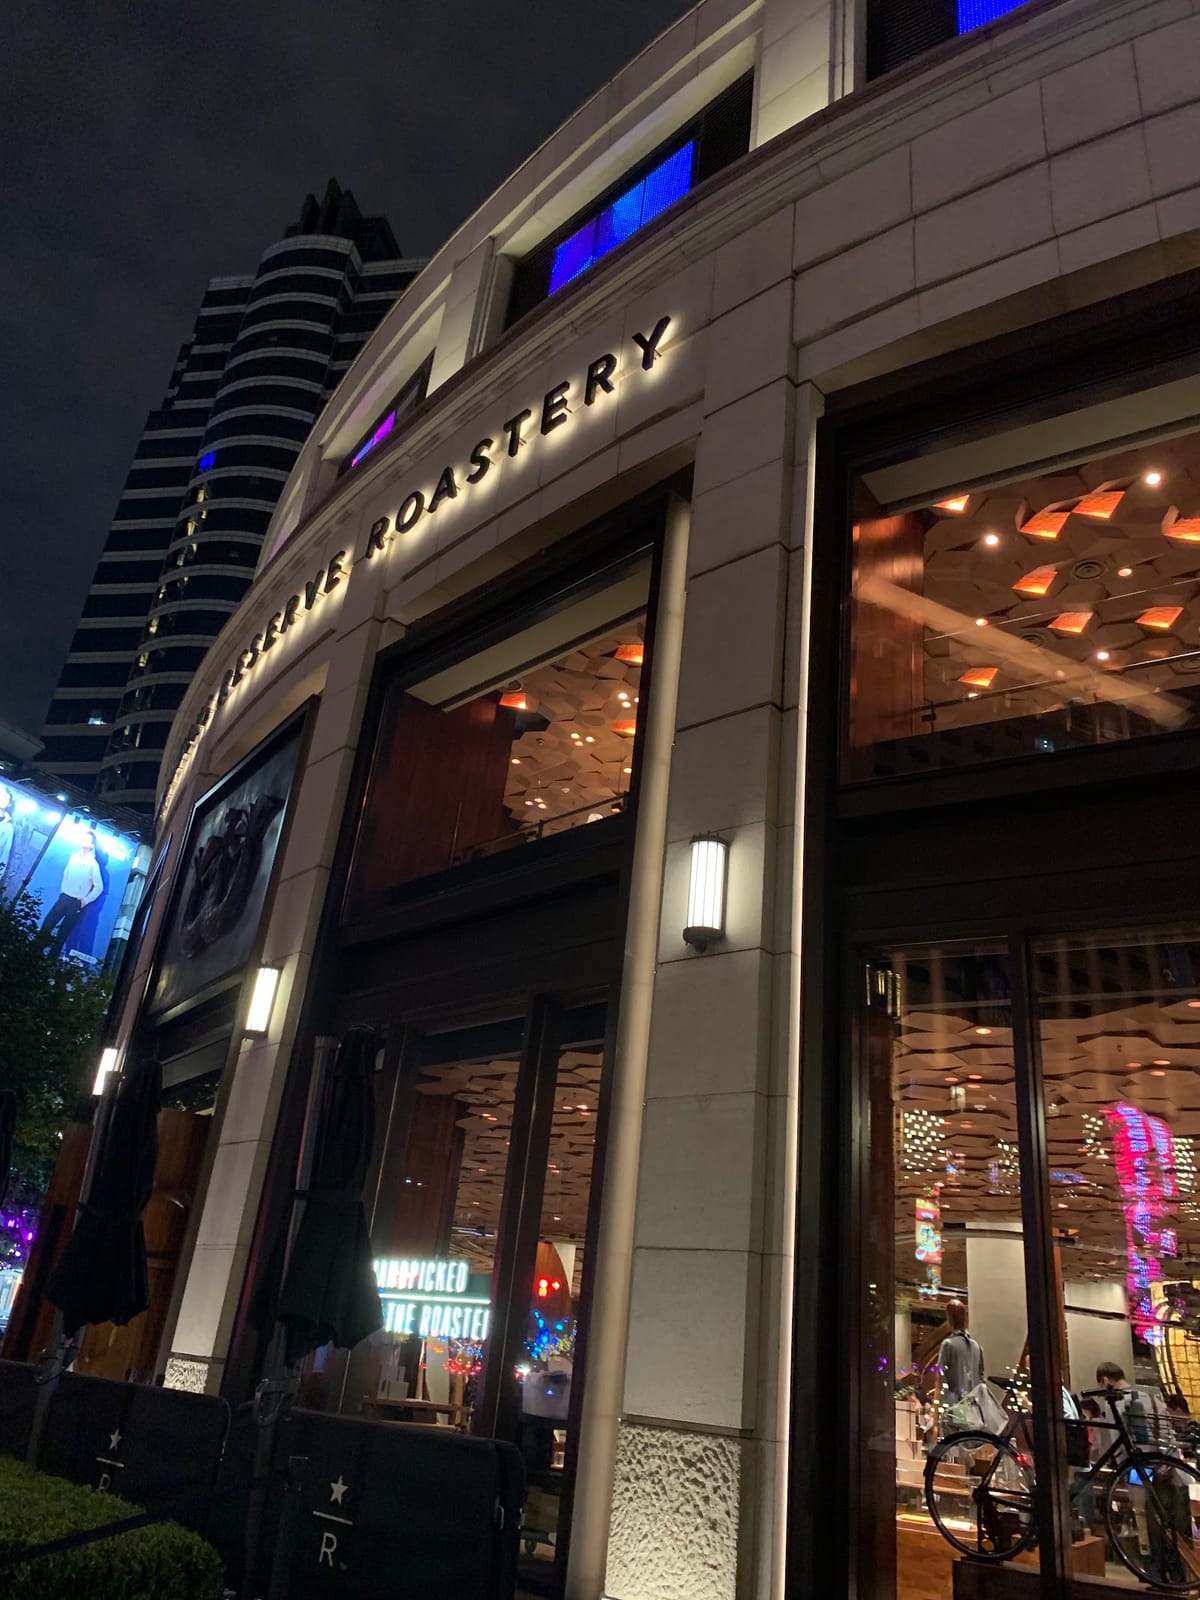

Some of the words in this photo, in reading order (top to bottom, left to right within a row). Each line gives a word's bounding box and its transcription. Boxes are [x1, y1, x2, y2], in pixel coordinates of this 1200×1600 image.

[214, 550, 345, 711] RESERVE
[366, 316, 671, 559] ROASTERY
[373, 1259, 468, 1292] ANDPICKED
[385, 1302, 416, 1335] THE
